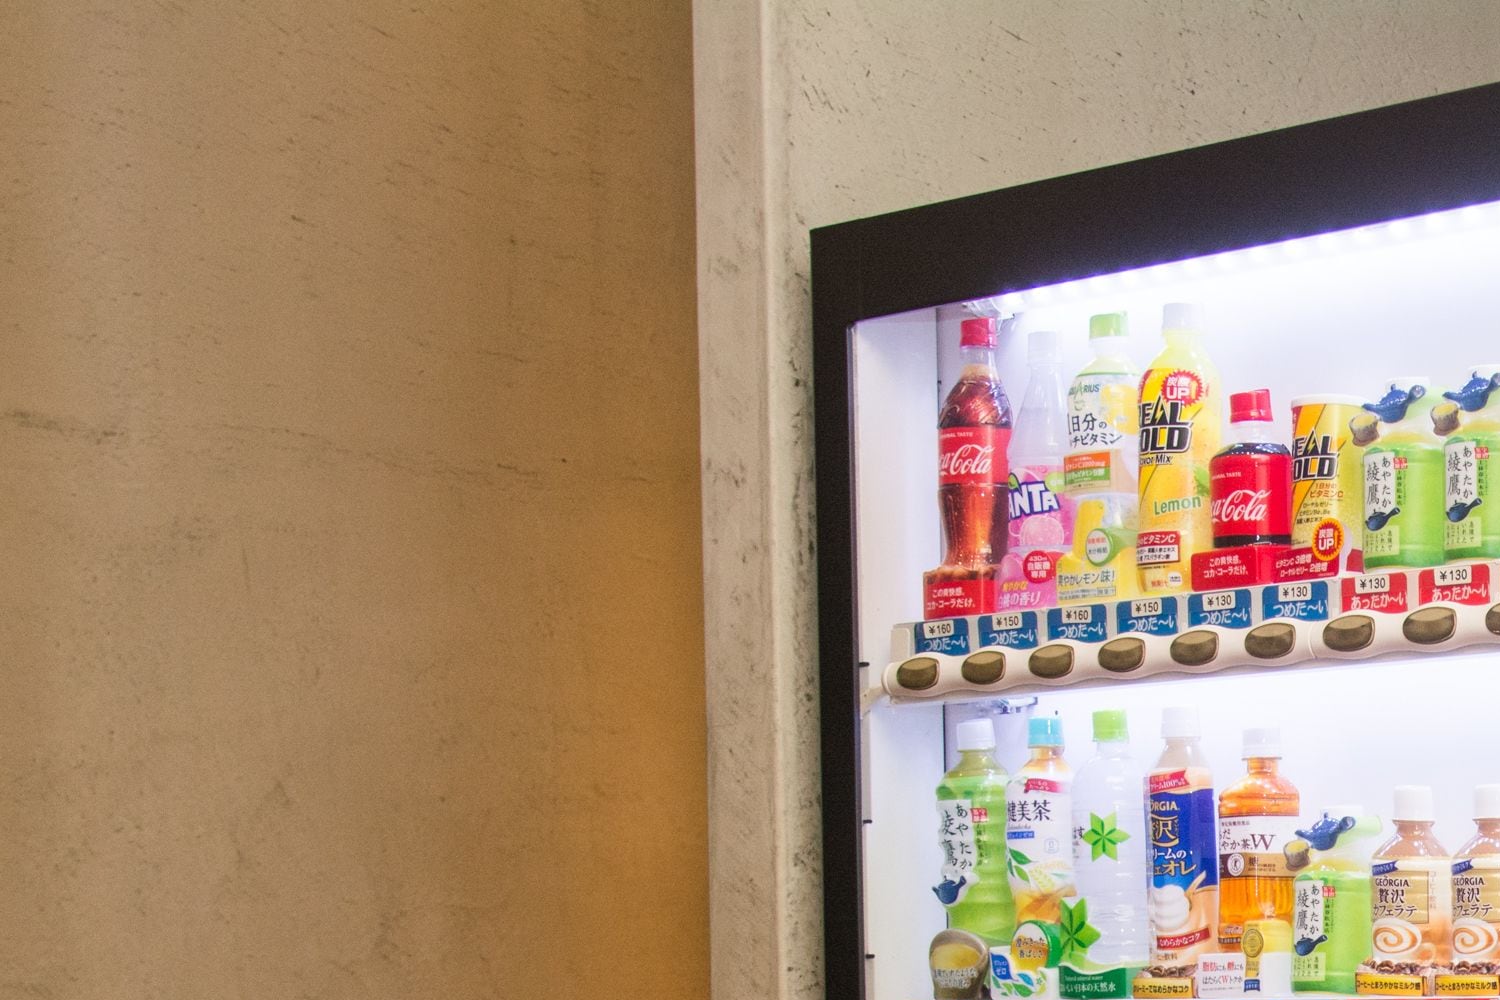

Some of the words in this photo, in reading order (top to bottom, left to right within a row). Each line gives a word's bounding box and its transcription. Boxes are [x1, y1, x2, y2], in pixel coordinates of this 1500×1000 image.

[1462, 445, 1473, 499] あやたか
[1381, 456, 1392, 508] あやたか
[1154, 496, 1202, 516] Lemon
[1439, 568, 1468, 581] ¥130
[1359, 577, 1386, 589] ¥130
[1283, 586, 1308, 598] ¥130
[1207, 594, 1232, 607] ¥130
[1135, 602, 1159, 613] ¥150
[996, 616, 1019, 626] ¥150
[1066, 609, 1089, 620] ¥160
[928, 624, 951, 635] ¥160
[956, 803, 972, 870] あやたか
[1375, 876, 1410, 888] GEORGIA
[1379, 888, 1405, 904] 贅沢
[1456, 887, 1480, 903] 贅沢
[1310, 884, 1320, 935] あやたか
